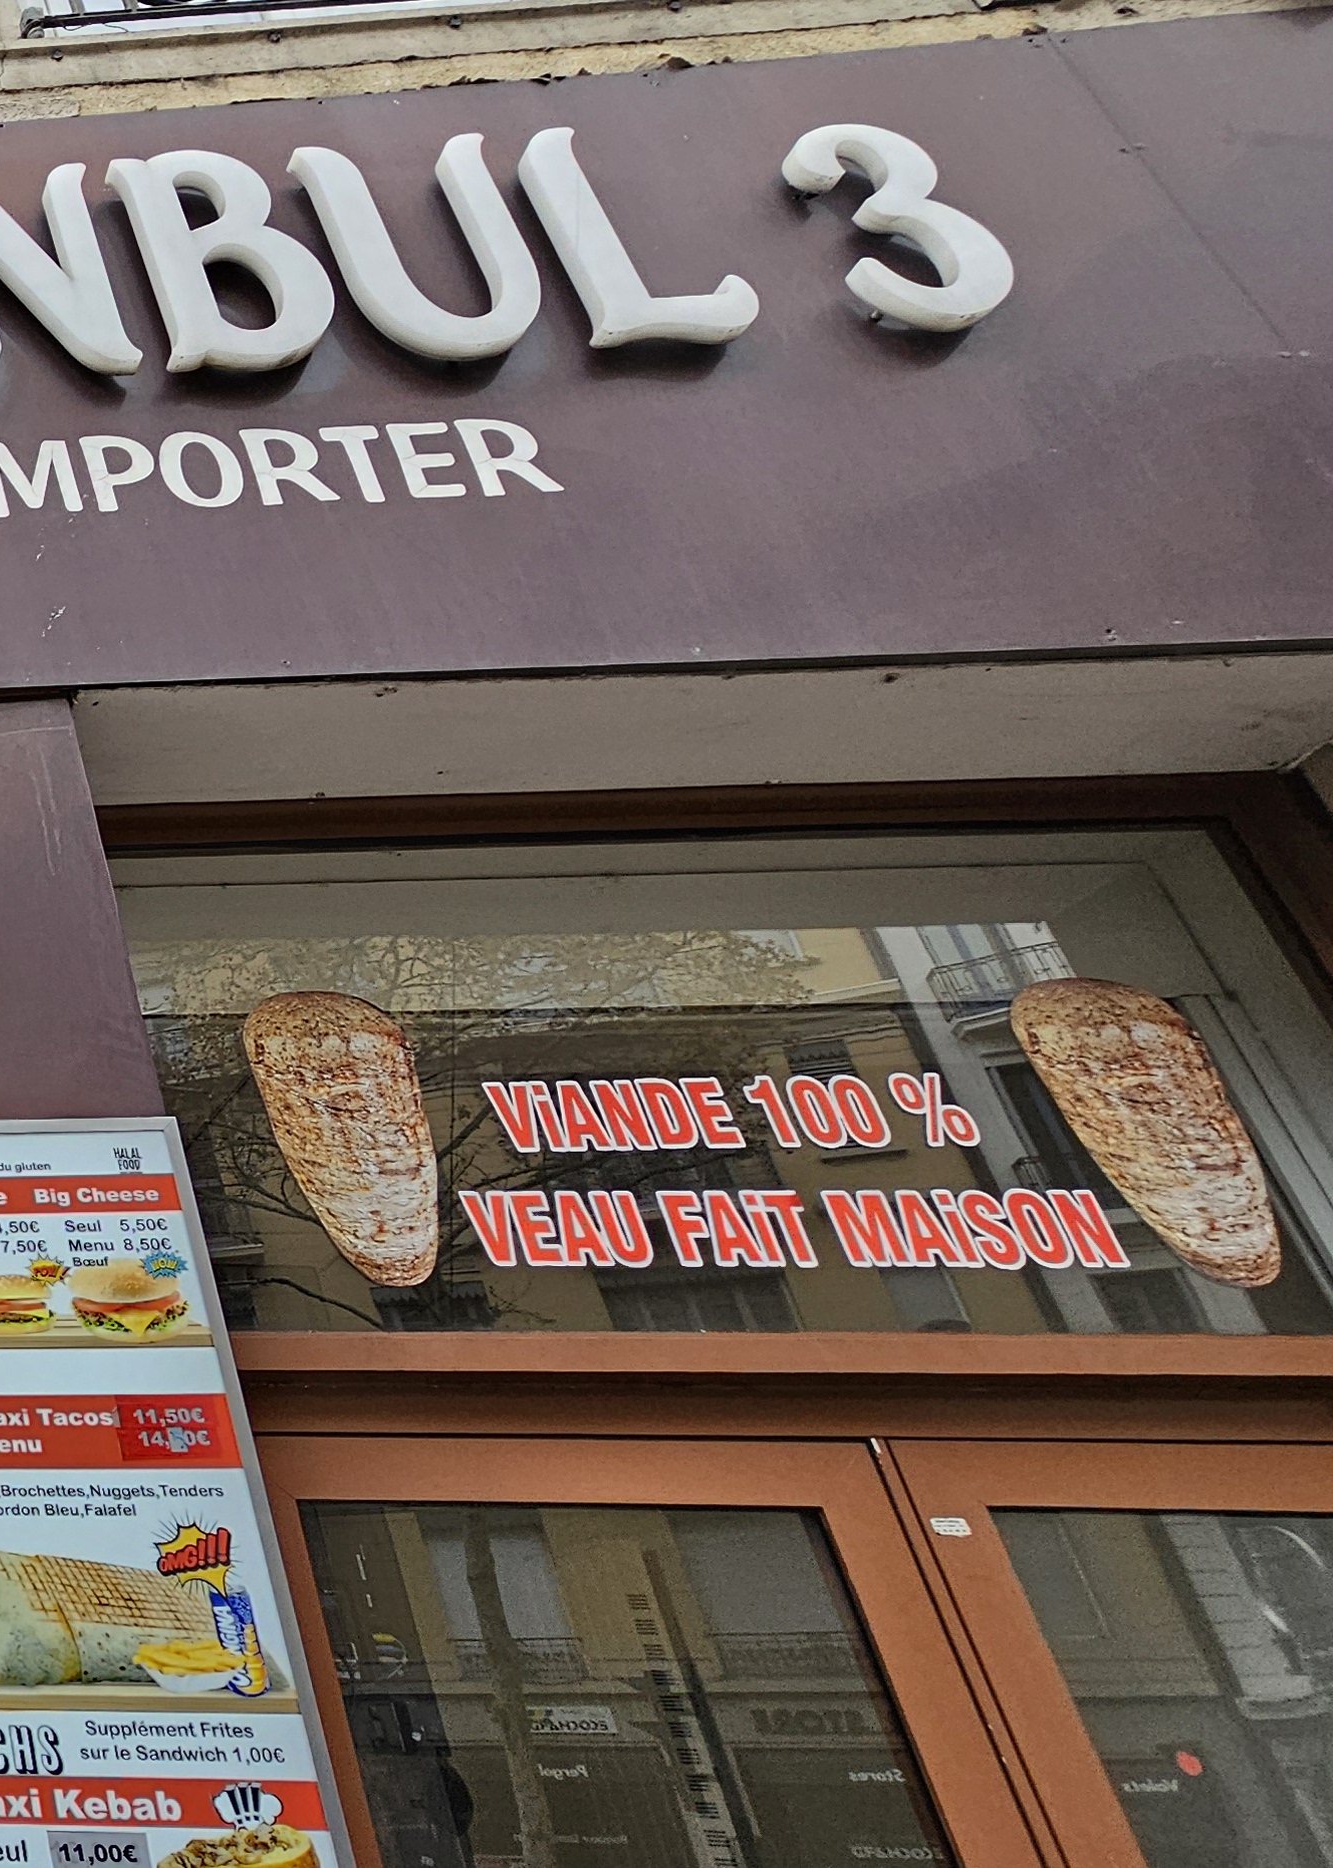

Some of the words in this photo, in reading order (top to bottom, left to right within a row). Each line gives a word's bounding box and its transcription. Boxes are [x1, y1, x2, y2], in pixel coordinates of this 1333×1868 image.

[780, 122, 1015, 333] 3
[745, 1072, 886, 1150] 100
[891, 1071, 981, 1149] %
[113, 1148, 143, 1159] HALAL
[15, 1162, 51, 1173] gluten
[119, 1159, 141, 1170] FOOD
[33, 1188, 71, 1207] Big
[76, 1187, 159, 1203] Cheese
[64, 1220, 102, 1233] Seul
[119, 1218, 168, 1233] 5,50€
[458, 1188, 654, 1268] VEAU
[0, 1240, 48, 1256] 7,50€
[68, 1239, 115, 1252] Menu
[123, 1238, 172, 1253] 8,50€
[72, 1256, 109, 1267] Bœuf
[36, 1408, 114, 1426] Tacos
[134, 1408, 206, 1427] 11,50€
[159, 1527, 231, 1574] OMG!!!
[85, 1721, 197, 1739] Supplément
[201, 1722, 254, 1738] Frites
[80, 1748, 110, 1760] sur
[115, 1746, 131, 1760] le
[135, 1747, 227, 1763] Sandwich
[232, 1748, 285, 1765] 1,00€
[53, 1788, 182, 1822] Kebab
[59, 1843, 138, 1866] 11,00€
